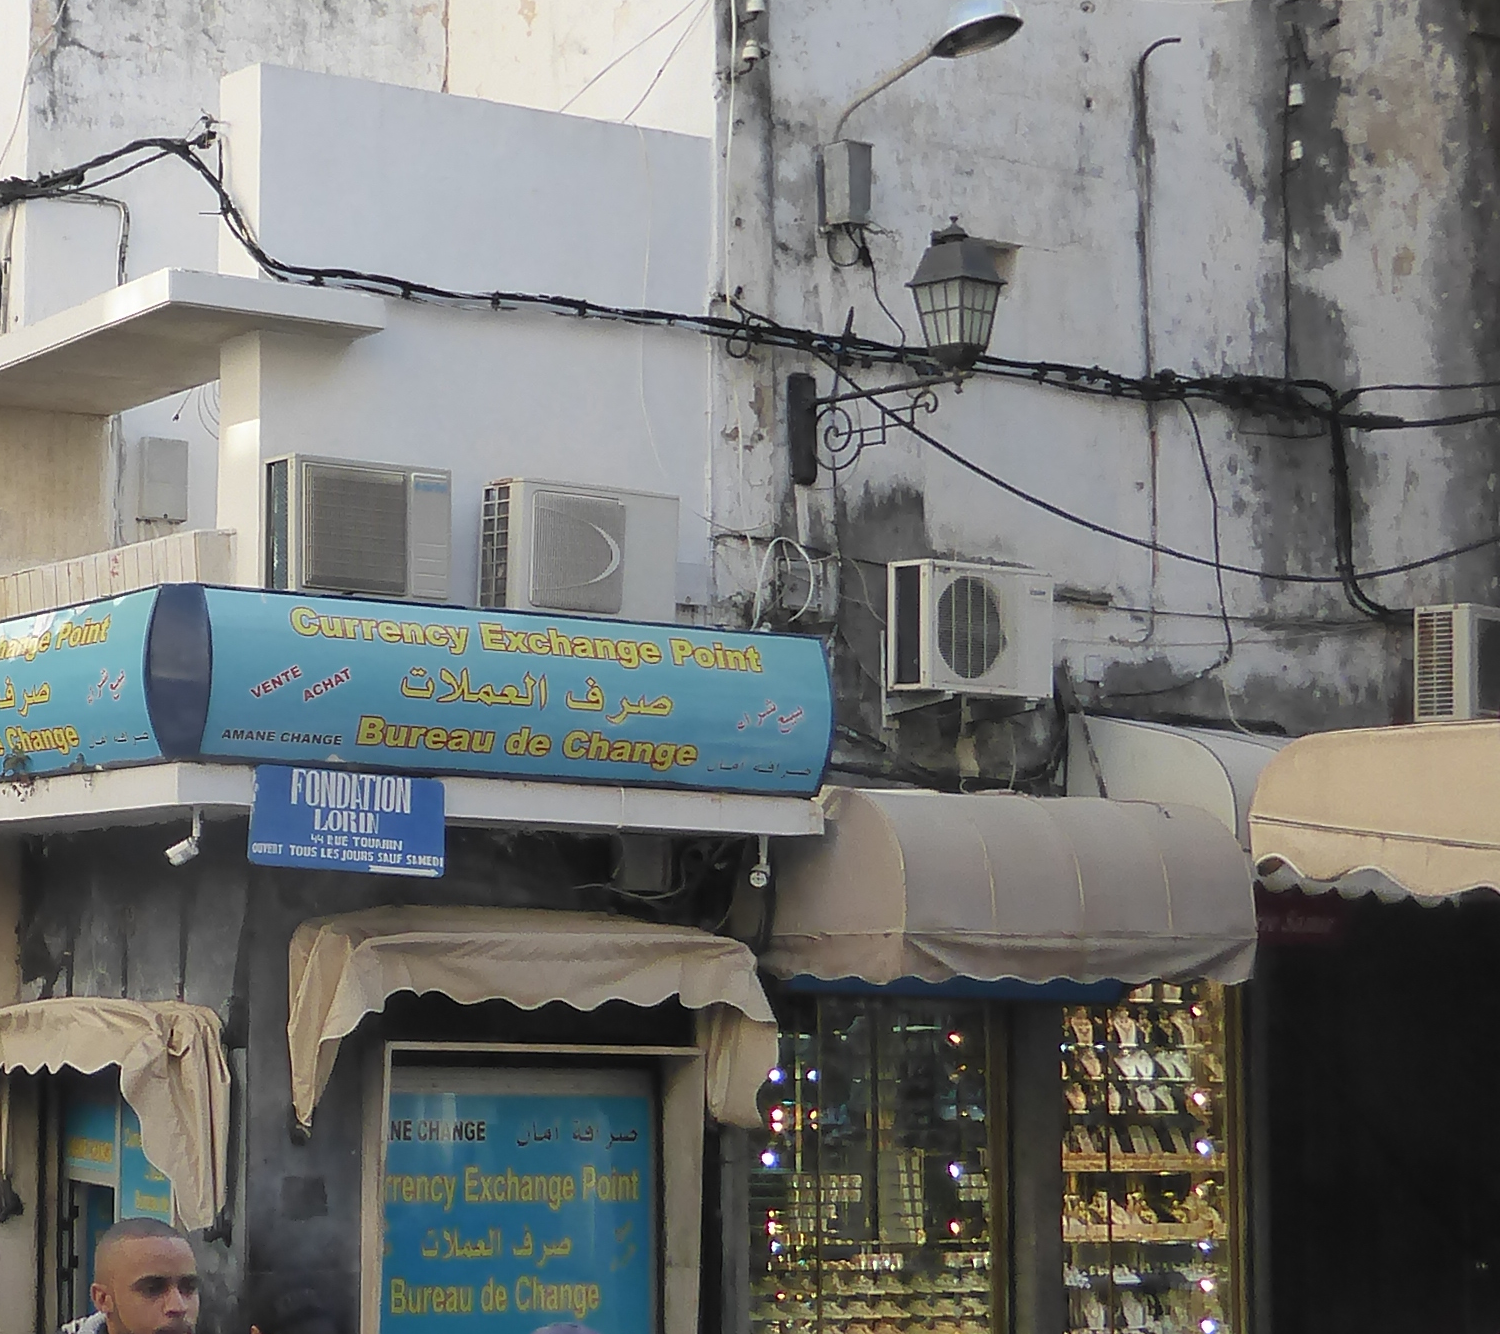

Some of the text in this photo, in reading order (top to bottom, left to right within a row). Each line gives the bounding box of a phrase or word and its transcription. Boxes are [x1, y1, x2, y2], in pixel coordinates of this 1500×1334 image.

[55, 614, 112, 650] Point
[289, 606, 763, 673] Currency Exchange Point
[250, 665, 303, 699] VENTE
[303, 666, 352, 703] ACHAT
[401, 667, 674, 725] صرف العملات
[4, 724, 80, 755] Change
[222, 729, 343, 746] AMANE CHANGE
[355, 715, 699, 772] Bureau de Change
[290, 768, 412, 814] FONDATION
[314, 808, 379, 834] LORIN
[251, 842, 444, 867] OUVERT TOUS LES JOURS SAUF SAMEDI
[310, 833, 325, 844] 44
[327, 834, 349, 847] RUE
[417, 1120, 487, 1142] CHANGE
[384, 1165, 640, 1212] rrency Exchange Point
[421, 1227, 502, 1259] العملات
[512, 1224, 573, 1267] صرف
[391, 1275, 600, 1319] Bureau de Change
